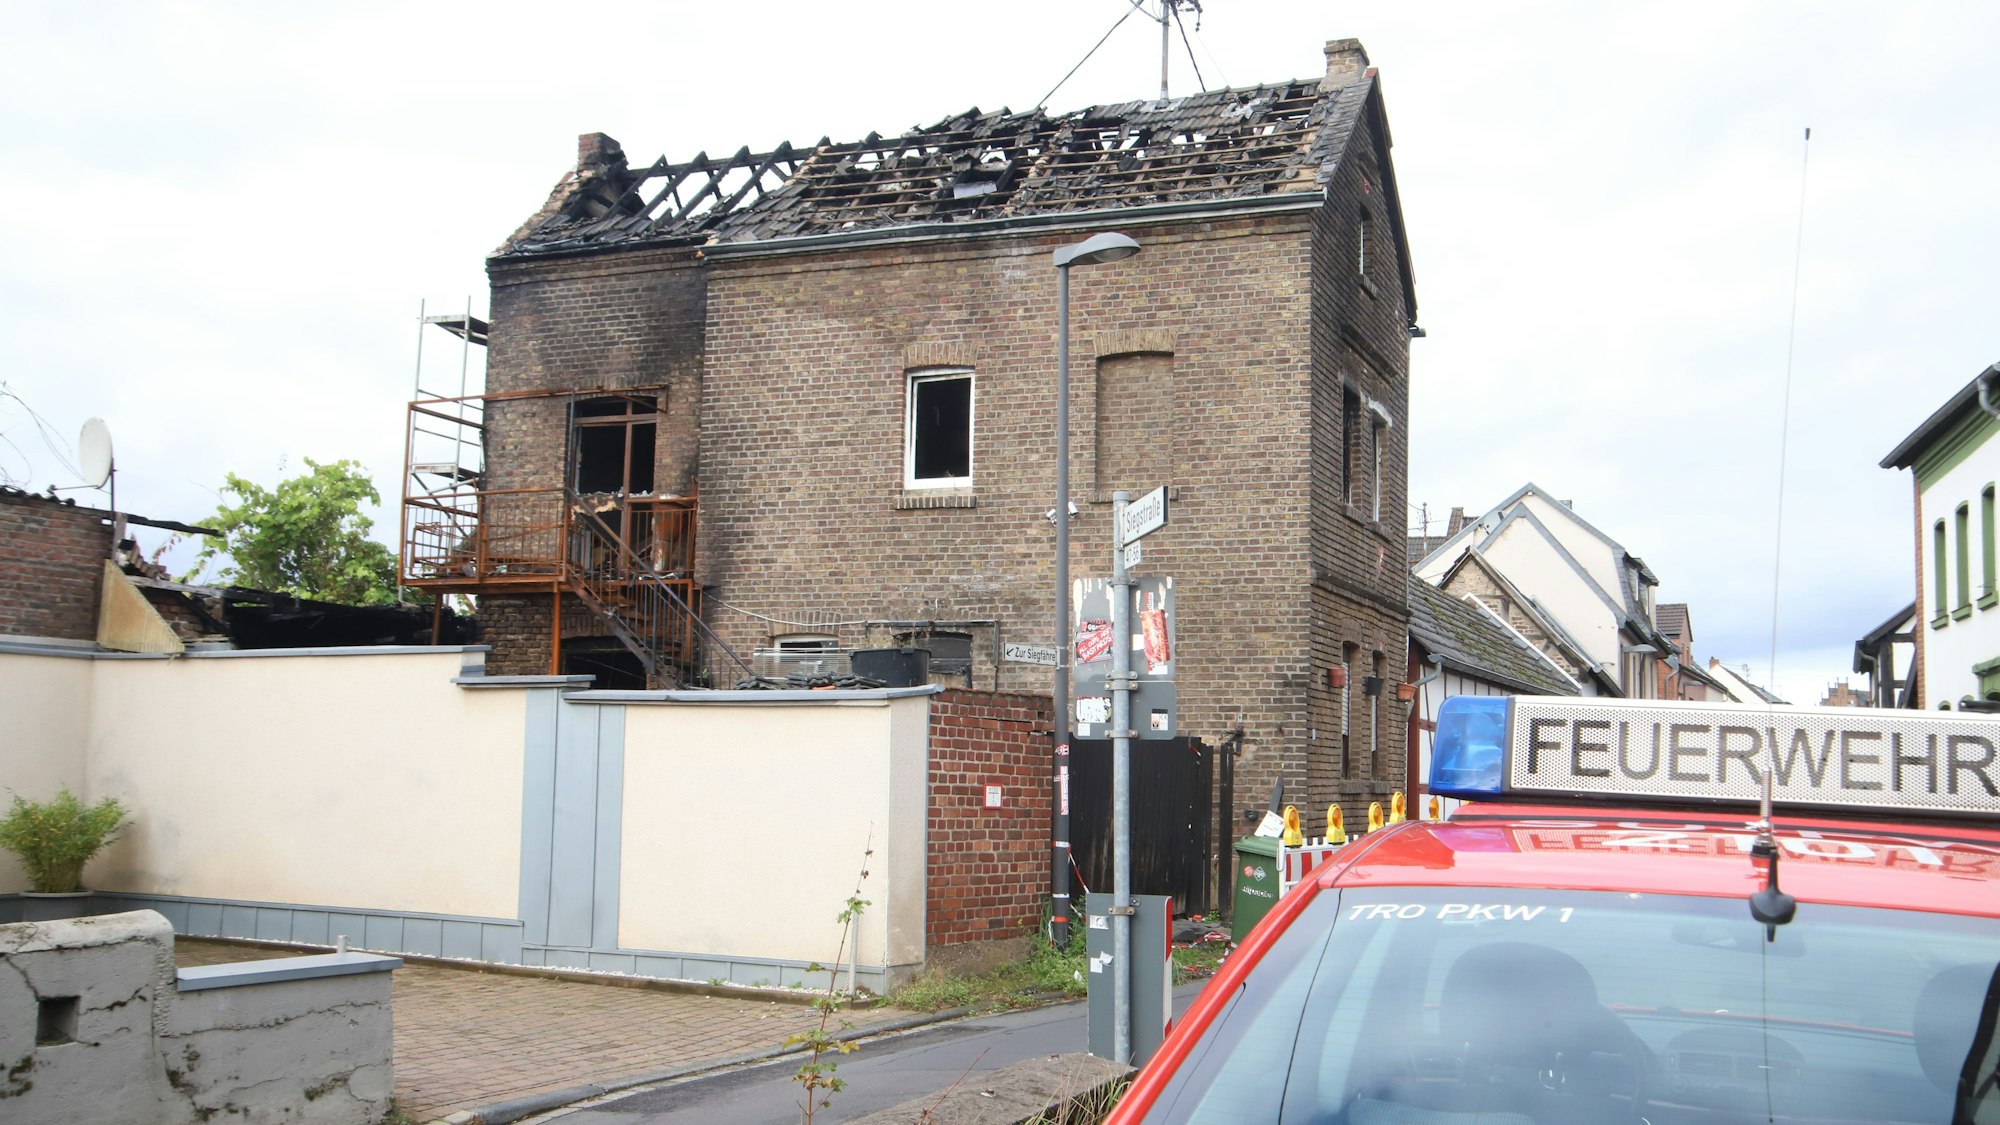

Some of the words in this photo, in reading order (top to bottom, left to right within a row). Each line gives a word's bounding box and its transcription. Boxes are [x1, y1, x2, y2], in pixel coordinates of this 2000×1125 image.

[1127, 497, 1161, 533] Siegstraße
[1015, 646, 1026, 658] Zur
[1527, 717, 2000, 797] FEUERWEHR
[1348, 903, 1426, 921] TRO
[1436, 903, 1546, 922] PKW
[1559, 907, 1574, 923] 1
